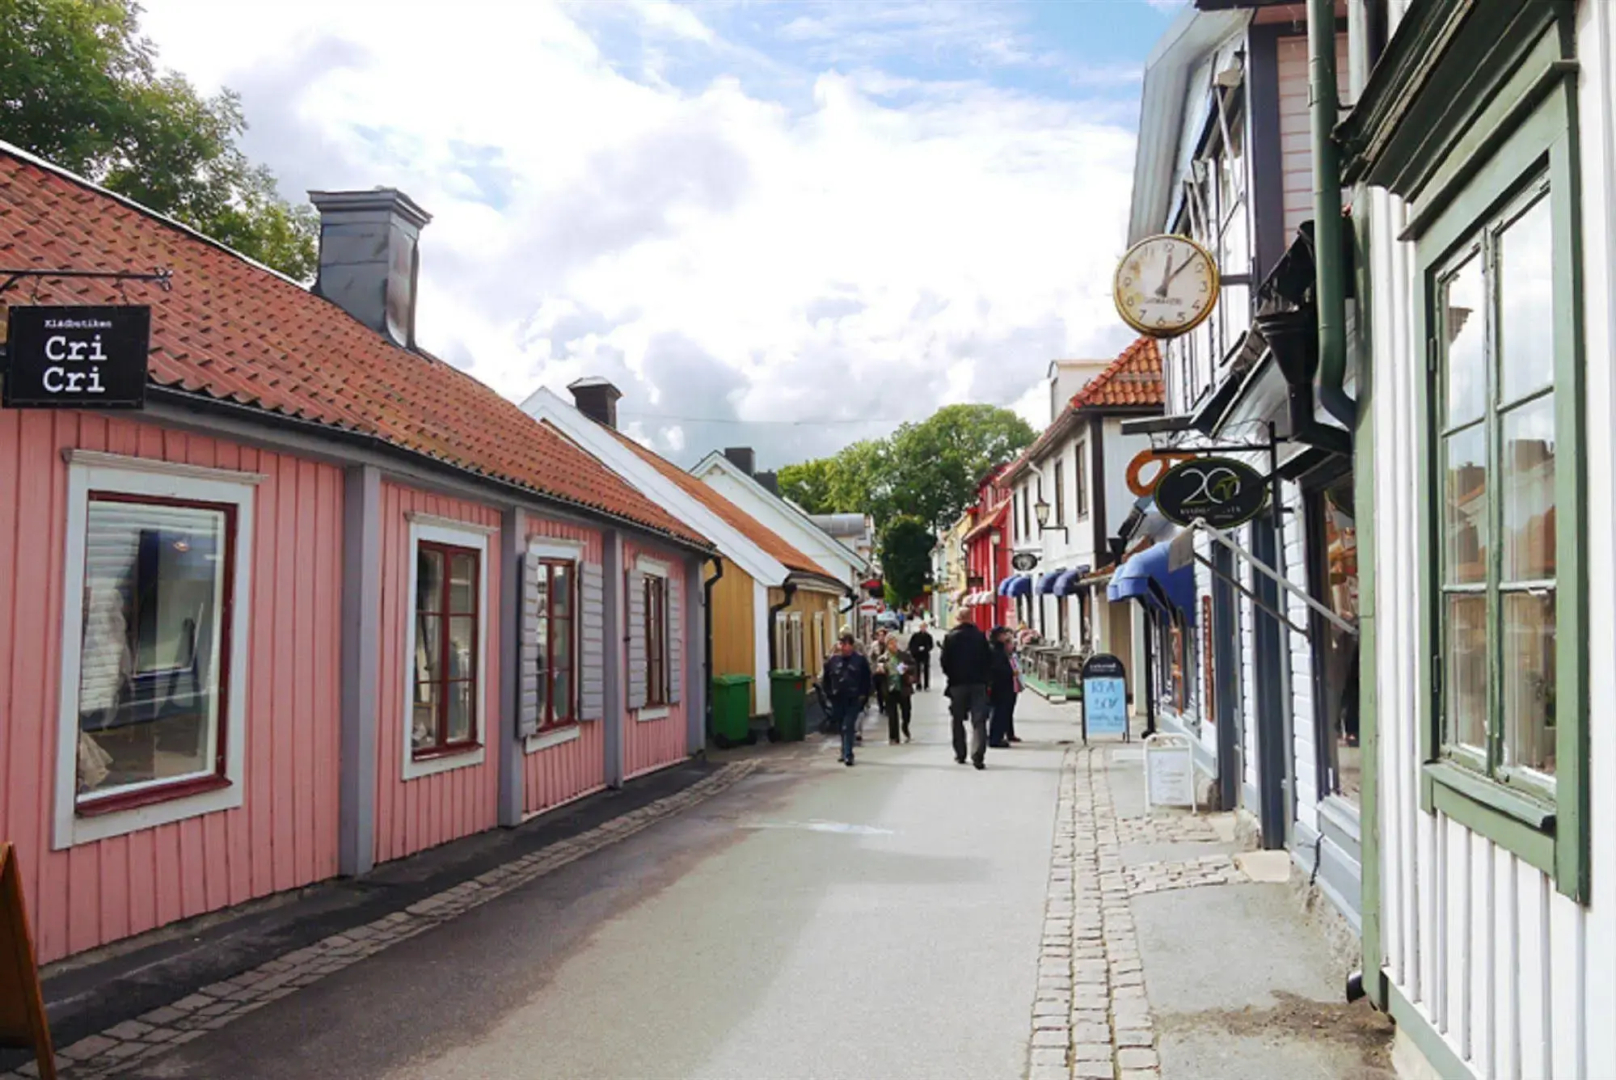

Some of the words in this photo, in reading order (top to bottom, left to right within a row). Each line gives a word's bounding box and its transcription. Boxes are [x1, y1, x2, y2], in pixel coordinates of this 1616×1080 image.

[1196, 262, 1205, 272] 2
[1199, 281, 1208, 293] 3
[1191, 300, 1200, 311] 4
[1139, 310, 1147, 320] 7
[1177, 312, 1186, 323] 5
[1157, 316, 1166, 327] 6
[45, 334, 108, 361] Cri
[43, 366, 106, 393] Cri
